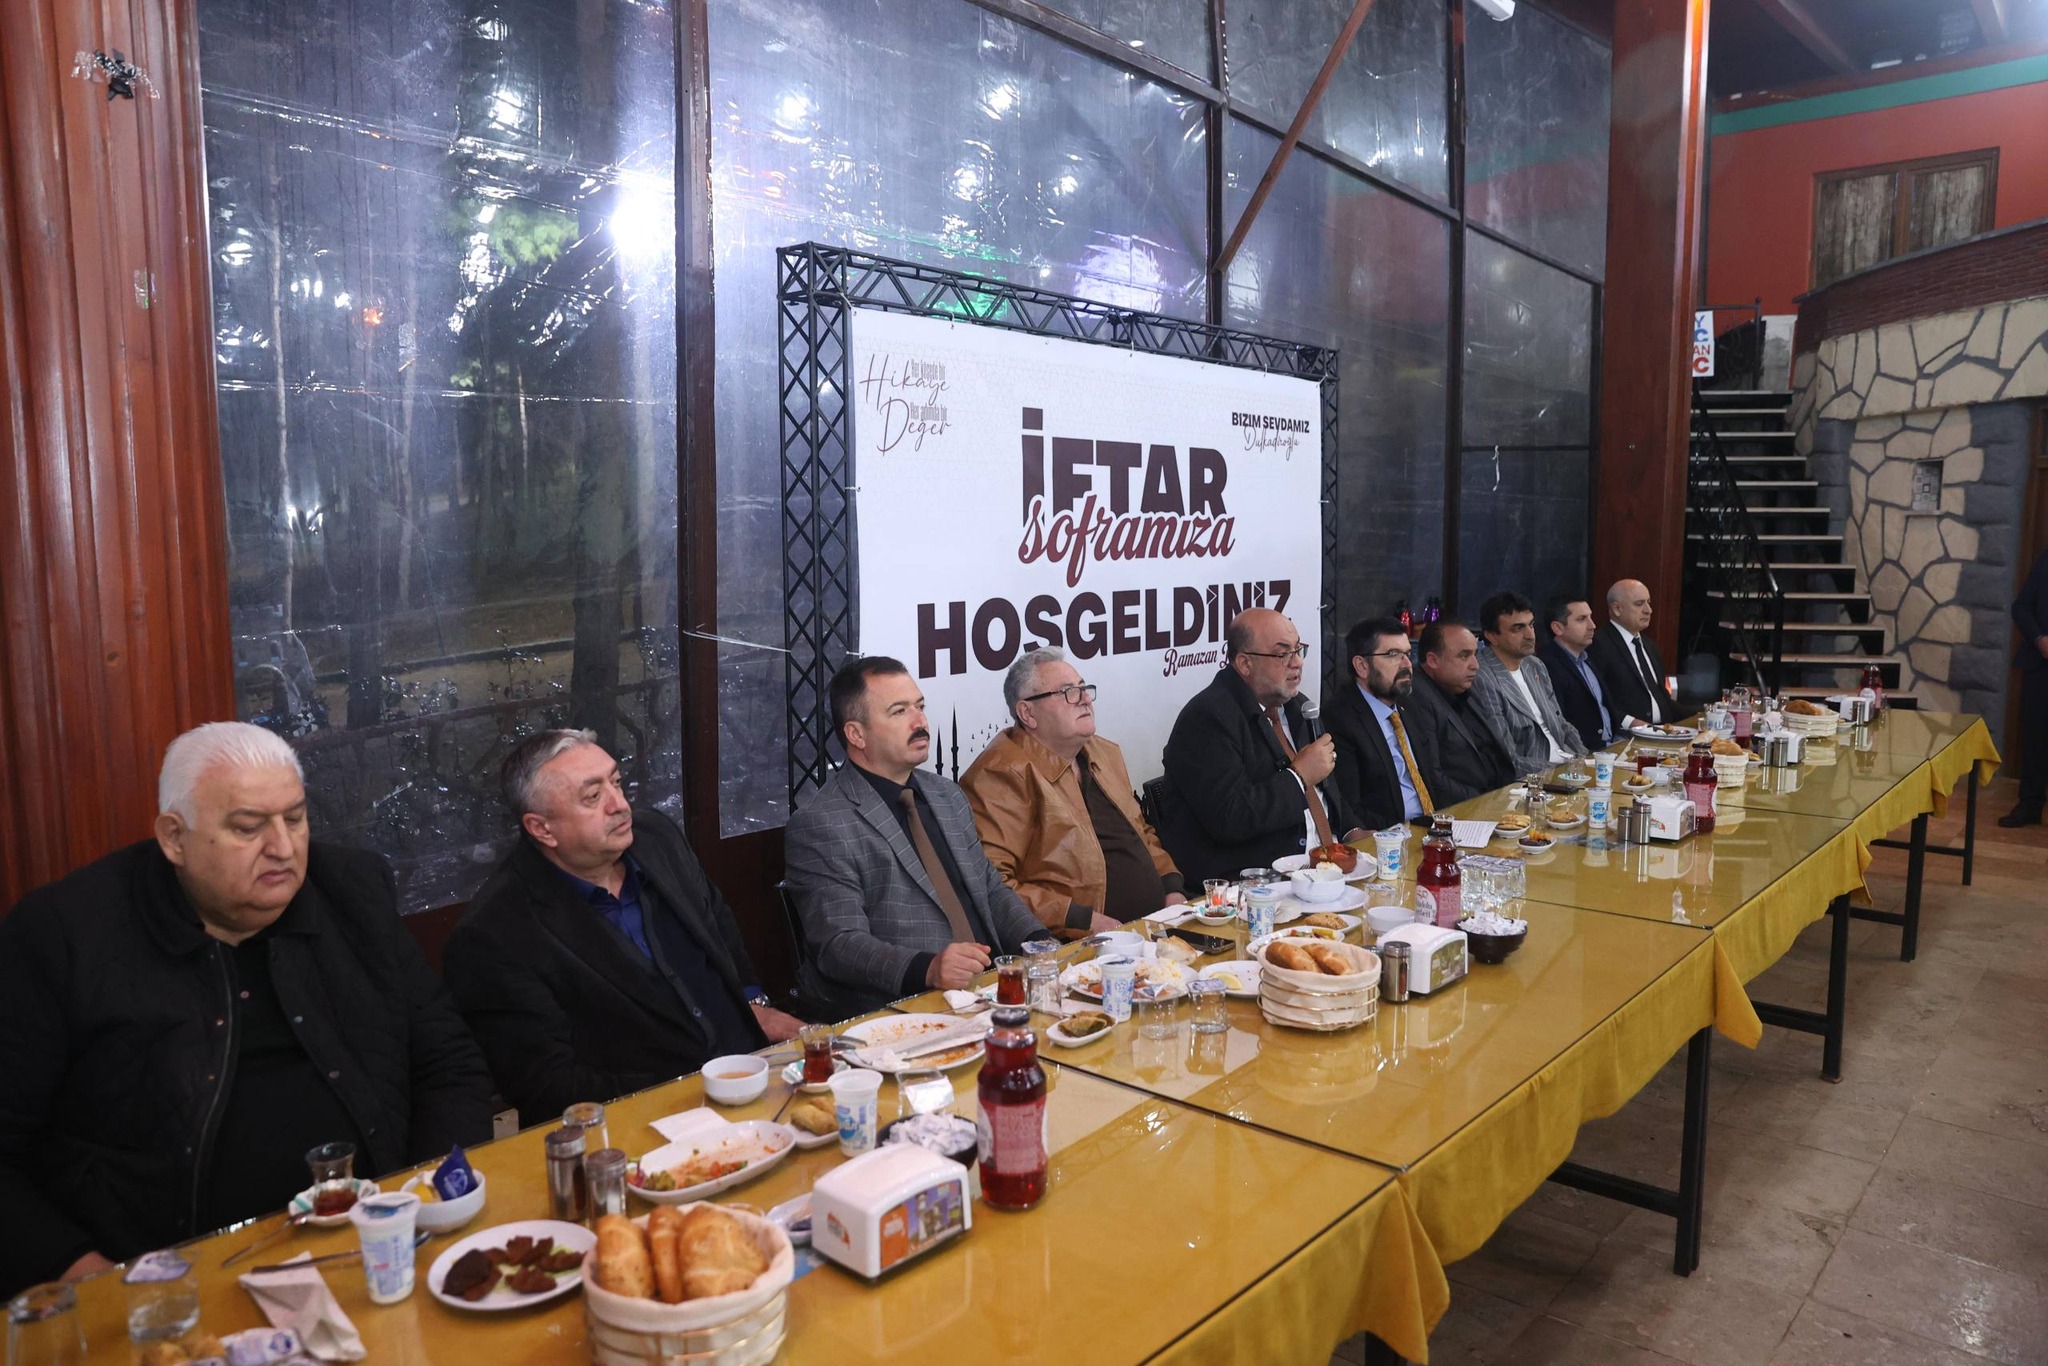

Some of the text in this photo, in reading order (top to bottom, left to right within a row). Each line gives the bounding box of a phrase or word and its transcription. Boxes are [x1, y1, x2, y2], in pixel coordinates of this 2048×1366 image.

[859, 354, 950, 411] Hikaye
[1263, 416, 1309, 433] SEVDAMIZ
[1163, 648, 1217, 677] Ramazan
